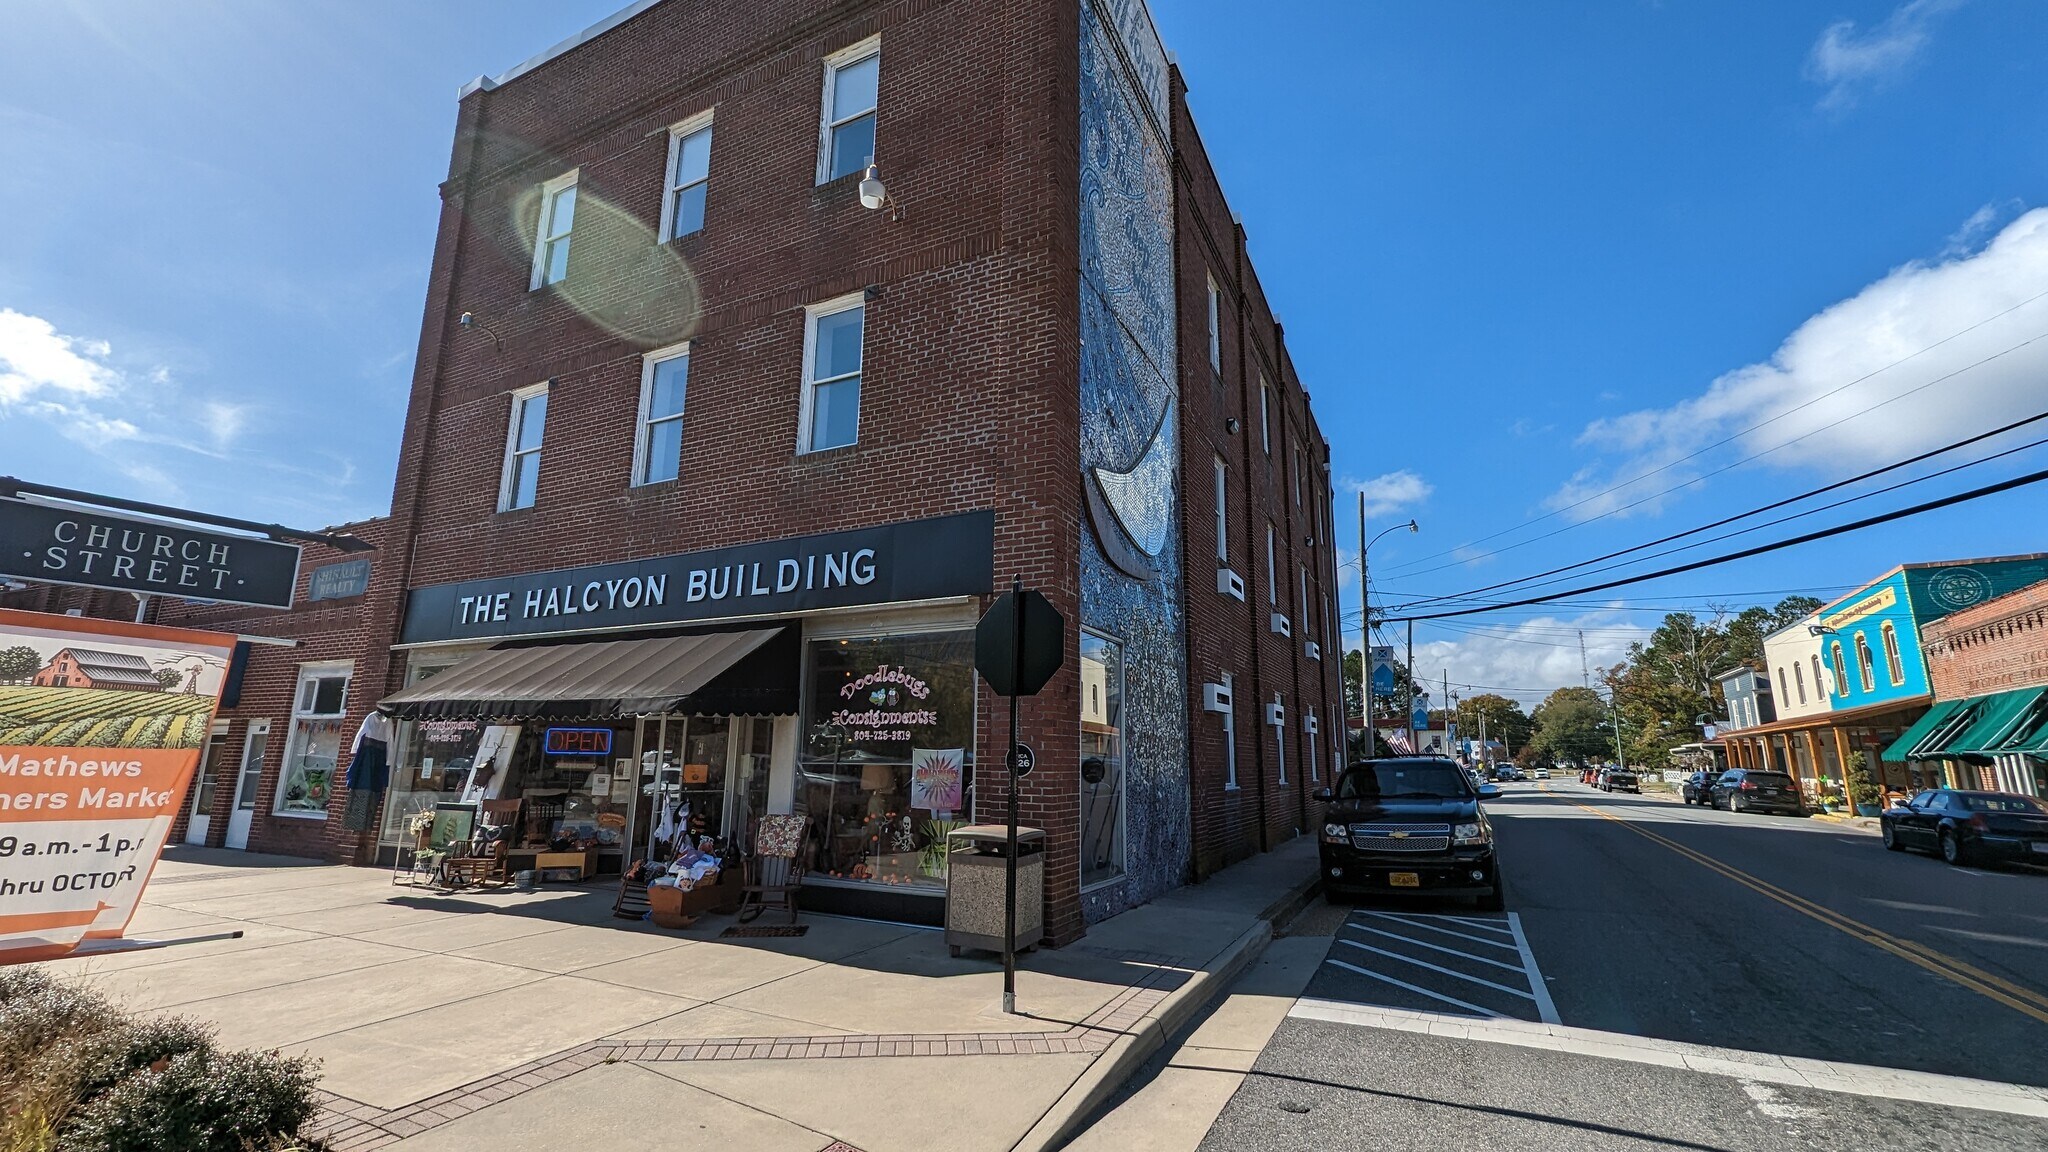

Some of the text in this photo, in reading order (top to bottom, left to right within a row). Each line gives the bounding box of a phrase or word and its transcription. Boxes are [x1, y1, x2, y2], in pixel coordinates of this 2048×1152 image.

[54, 521, 230, 566] CHURCH
[42, 546, 231, 591] STREET
[320, 579, 356, 596] REALTY
[460, 548, 876, 625] THE HALCYON BUILDING
[840, 664, 931, 700] Doodlebugs
[839, 708, 930, 729] Consignments
[548, 731, 610, 752] OPEN
[853, 730, 912, 741] 804-725-3819
[0, 753, 143, 778] Mathews
